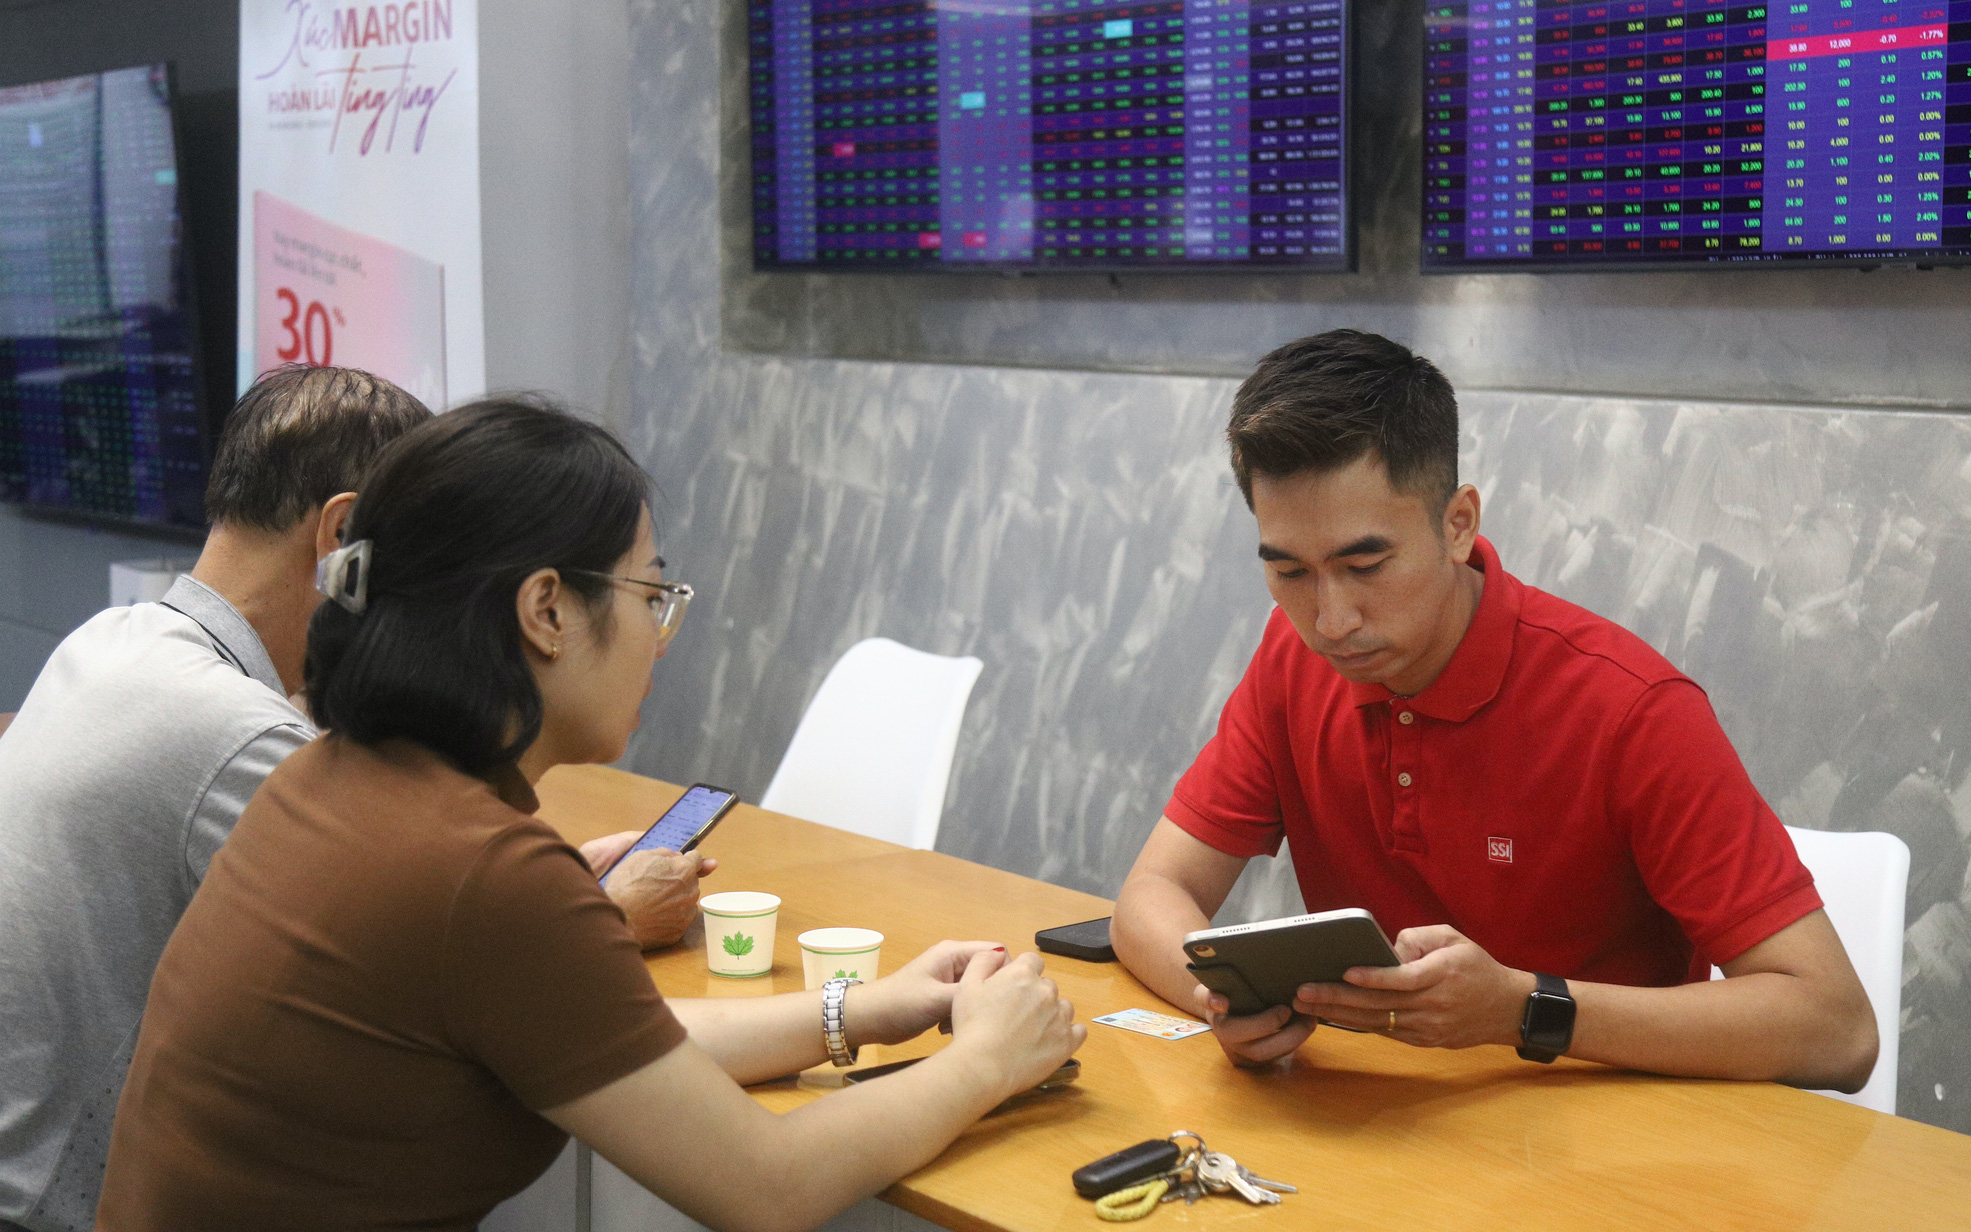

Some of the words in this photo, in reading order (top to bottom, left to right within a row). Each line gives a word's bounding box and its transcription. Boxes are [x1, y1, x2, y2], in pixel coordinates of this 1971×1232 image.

[333, 0, 453, 48] MARGIN
[1829, 38, 1852, 49] 12,000
[1879, 34, 1897, 44] -0.70
[1919, 29, 1944, 40] -1.77%
[1837, 58, 1851, 69] 200
[1880, 54, 1897, 65] 0.10
[1837, 77, 1851, 88] 100
[1880, 73, 1896, 85] 2.40
[1921, 70, 1943, 81] 1.20%
[1879, 93, 1896, 104] 0.20
[1920, 90, 1943, 101] 1.27%
[1787, 120, 1806, 131] 10.00
[1837, 117, 1850, 127] 100
[1879, 113, 1895, 124] 0.00
[1919, 110, 1942, 122] 0.00%
[1830, 136, 1849, 147] 4,000
[1878, 133, 1895, 144] 0.00
[1918, 131, 1941, 142] 0.00%
[1830, 156, 1849, 167] 1,100
[1877, 153, 1894, 164] 0.40
[1918, 151, 1941, 162] 2.02%
[1835, 176, 1848, 186] 100
[1877, 173, 1894, 184] 0.00
[1917, 171, 1940, 182] 0.00%
[1834, 195, 1848, 205] 100
[1876, 193, 1893, 204] 0.30
[1833, 214, 1847, 225] 200
[1916, 211, 1939, 222] 2.40%
[1828, 234, 1847, 245] 1,000
[1875, 233, 1892, 243] 0.00
[1915, 231, 1938, 242] 0.00%
[1491, 842, 1510, 858] SSI
